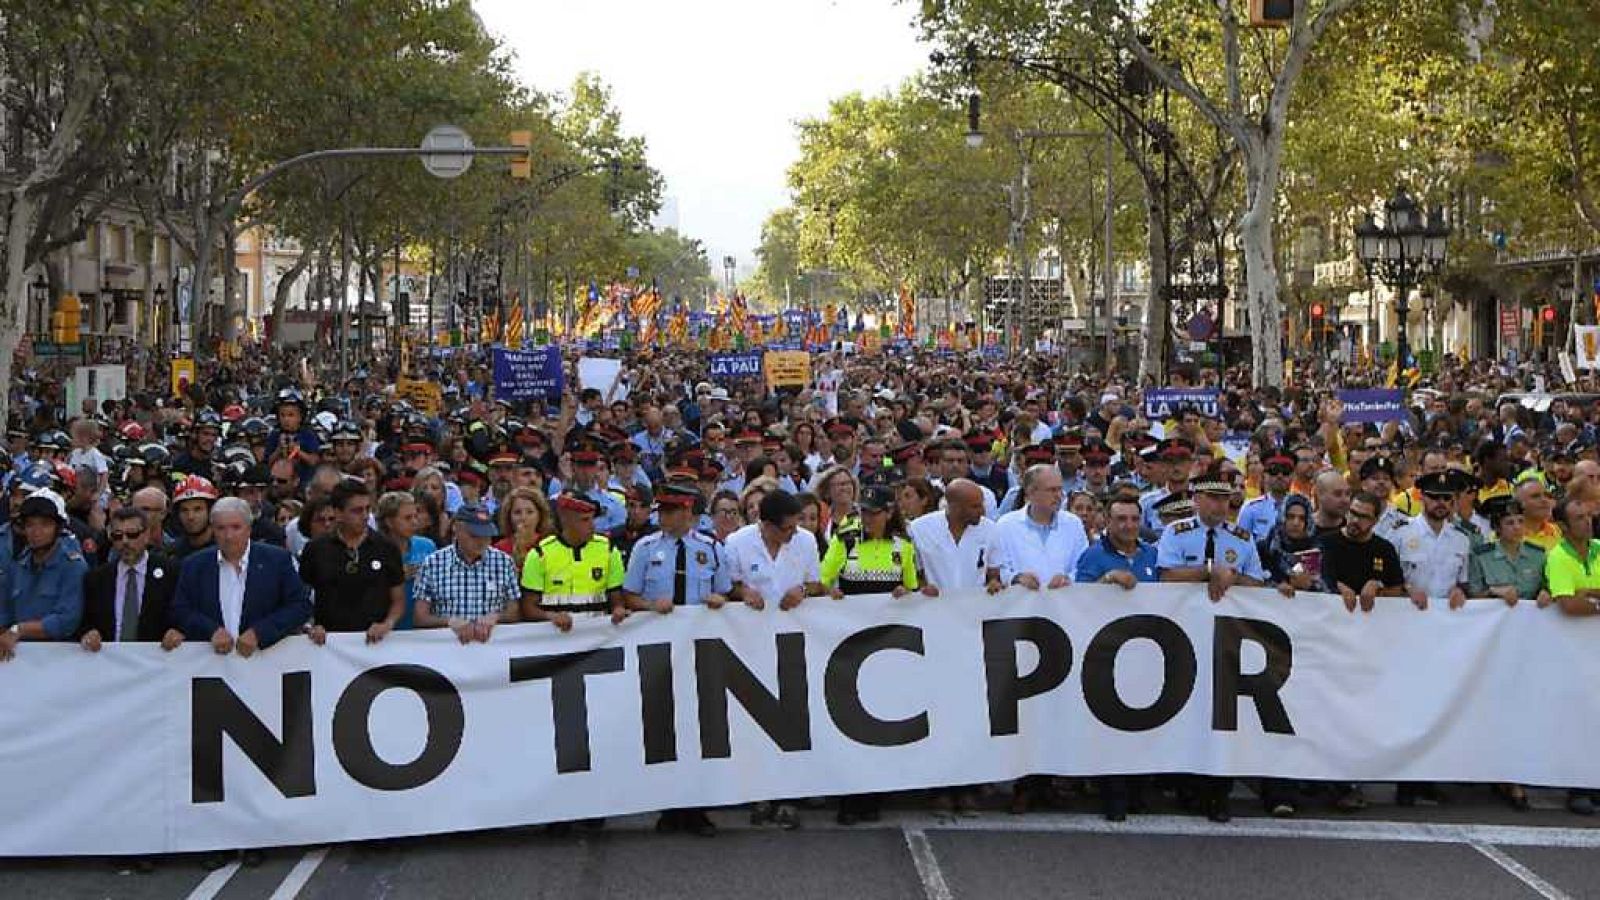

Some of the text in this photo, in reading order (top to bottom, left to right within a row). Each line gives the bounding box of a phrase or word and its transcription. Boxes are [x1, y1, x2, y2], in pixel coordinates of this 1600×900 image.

[711, 361, 728, 374] LA
[731, 355, 759, 374] PAU
[1146, 401, 1172, 417] LA
[192, 614, 1296, 803] NO TINC POR
